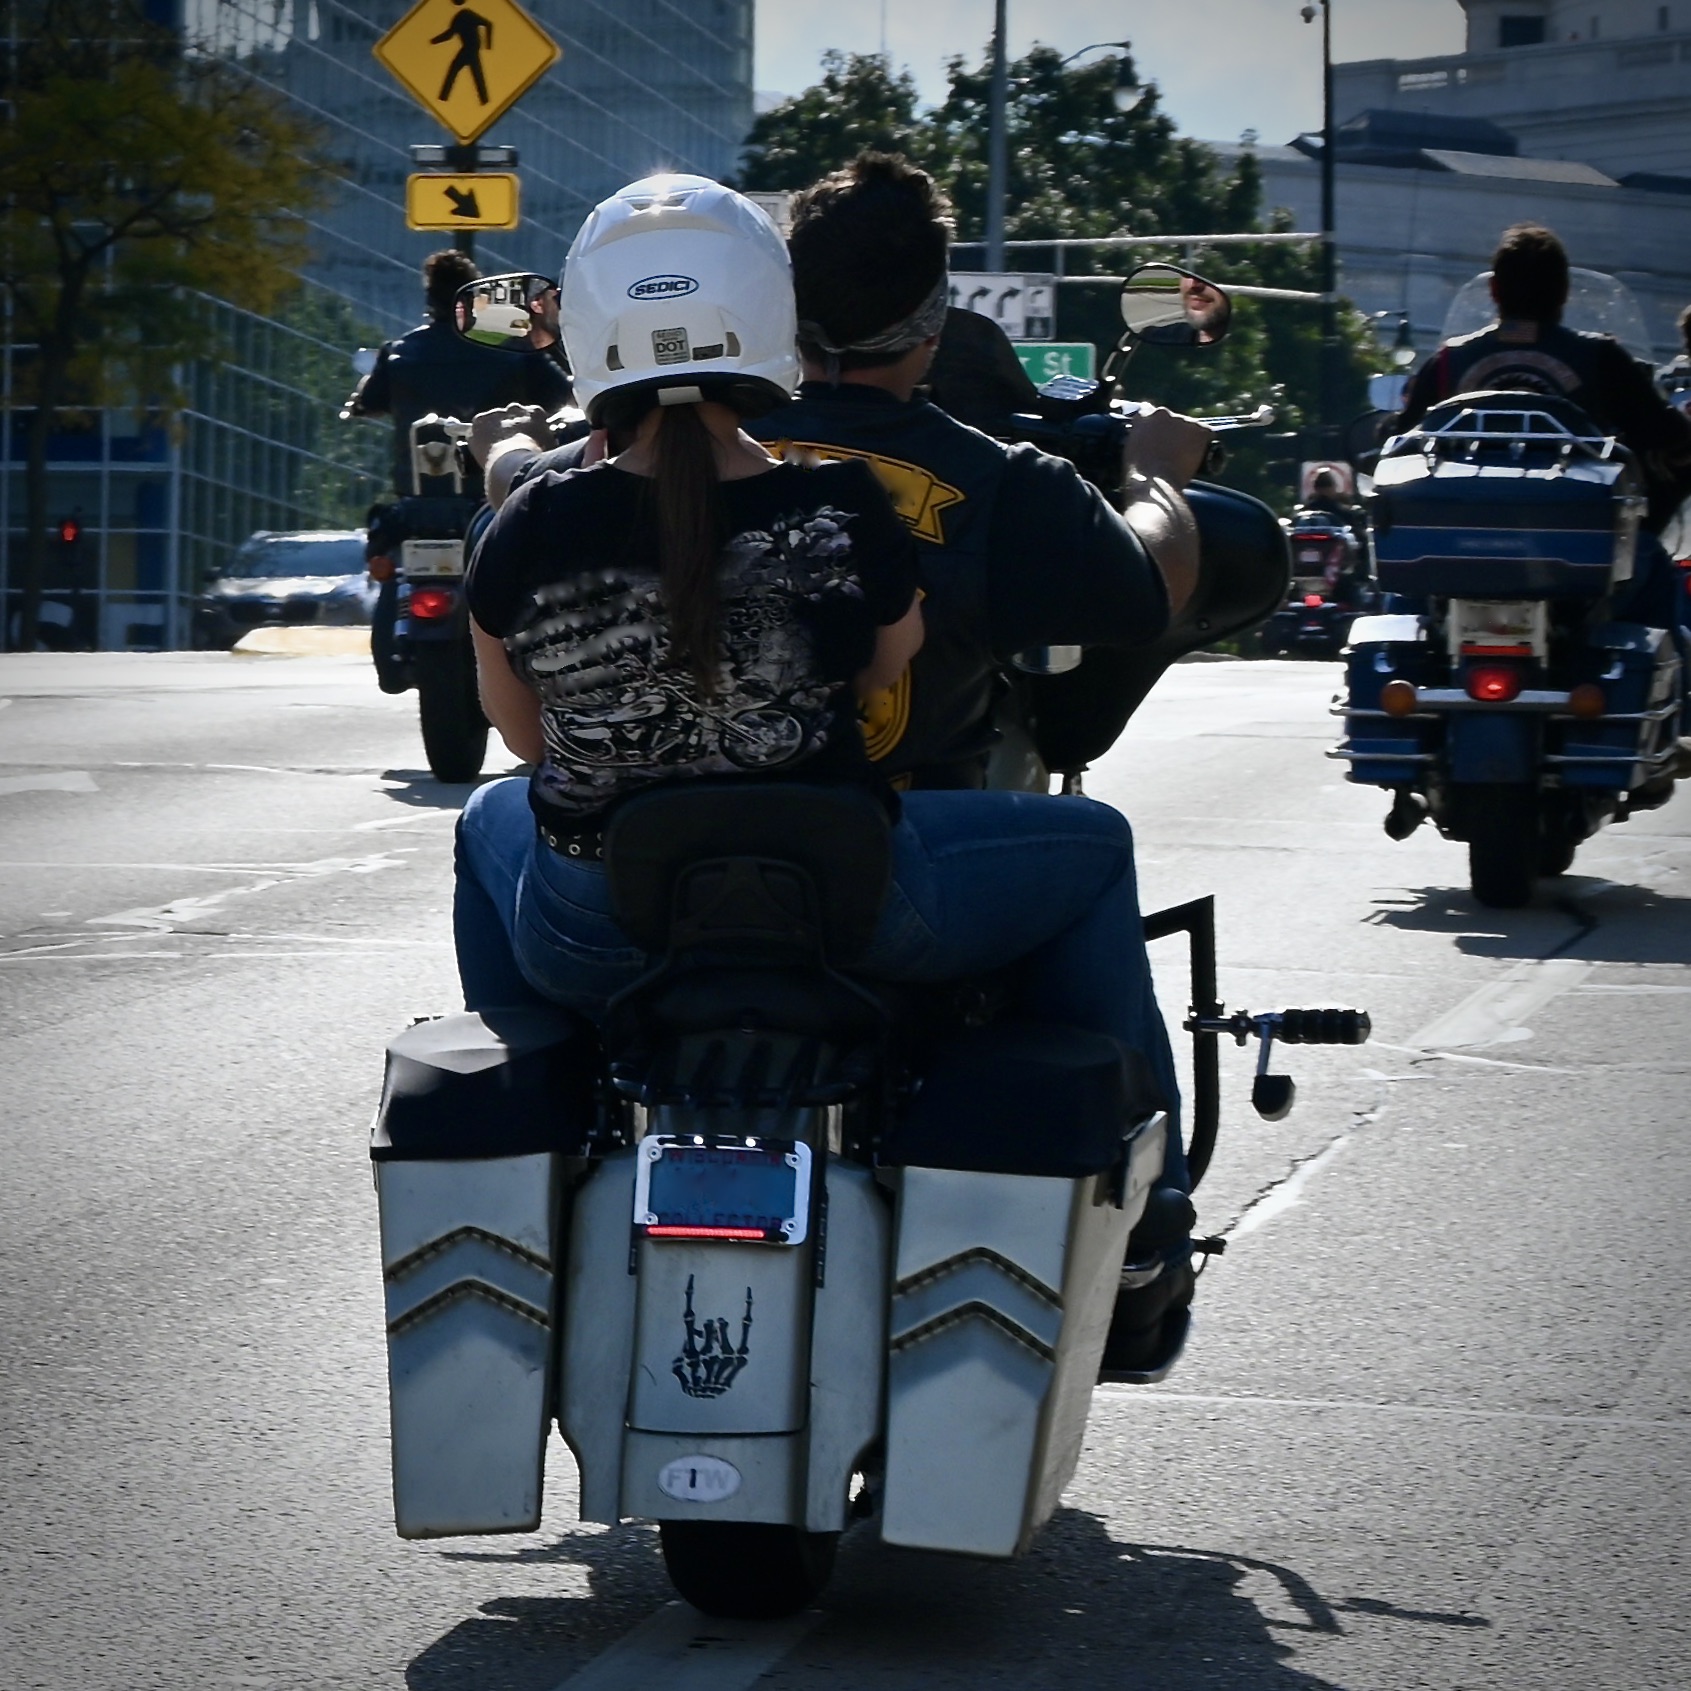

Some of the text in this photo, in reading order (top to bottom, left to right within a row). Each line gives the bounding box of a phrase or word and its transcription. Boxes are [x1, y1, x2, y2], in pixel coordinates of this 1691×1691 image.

[634, 280, 691, 296] SEDICI
[655, 340, 686, 353] DOT
[1043, 351, 1072, 376] St
